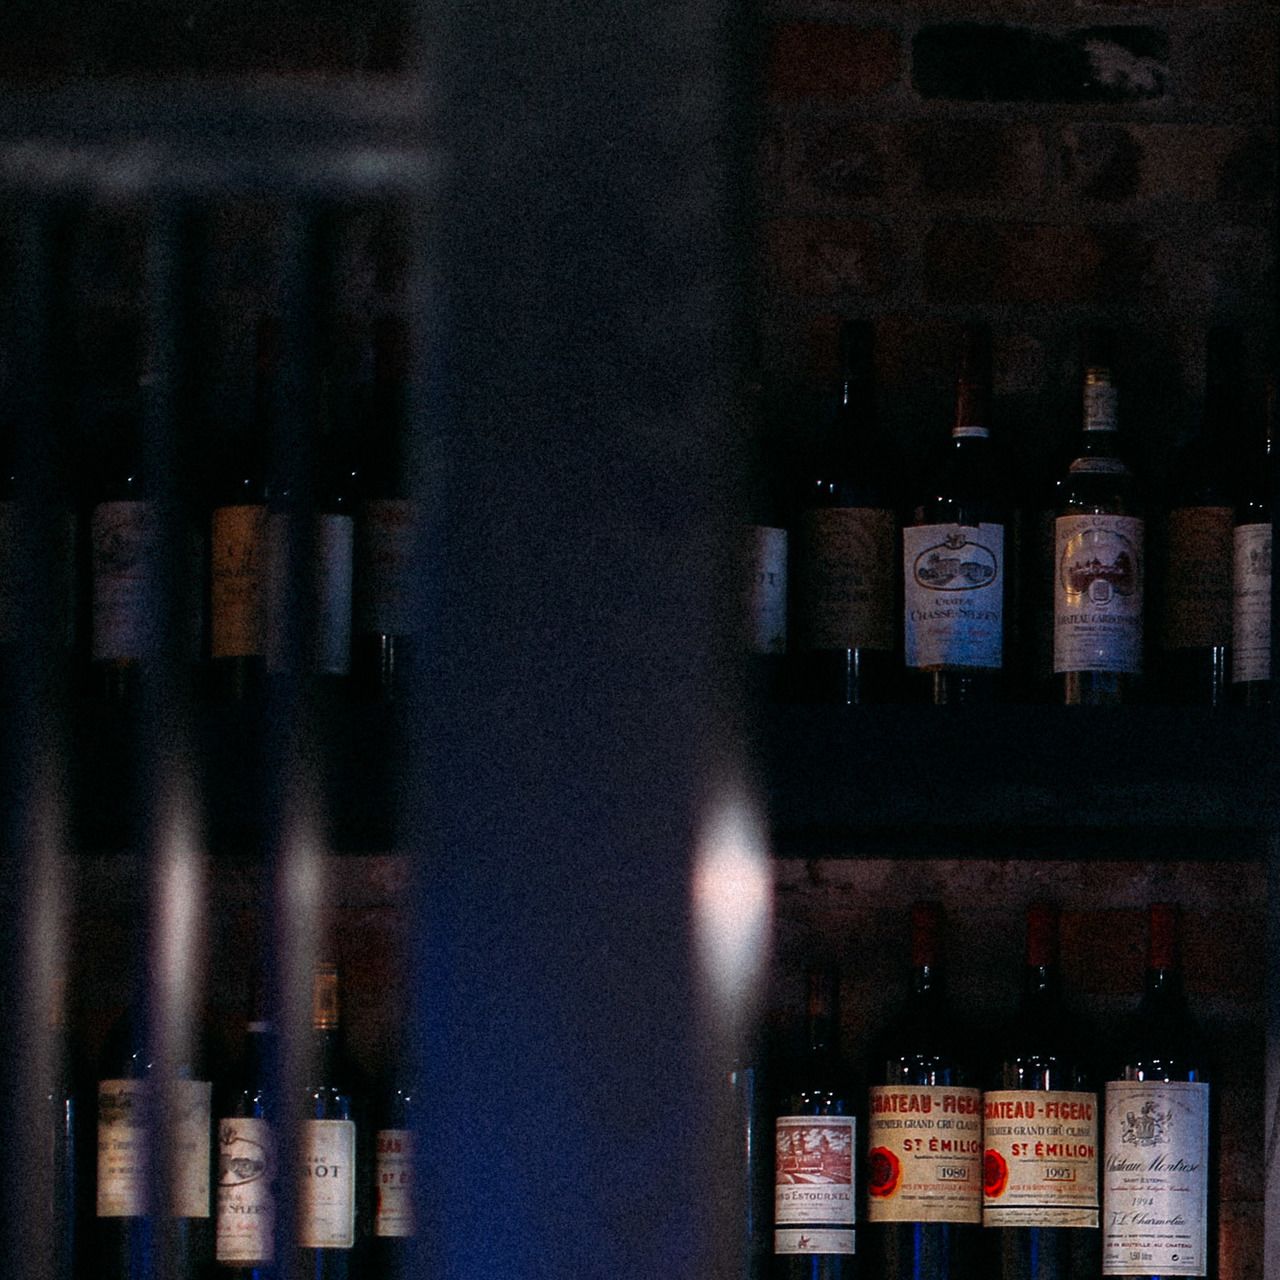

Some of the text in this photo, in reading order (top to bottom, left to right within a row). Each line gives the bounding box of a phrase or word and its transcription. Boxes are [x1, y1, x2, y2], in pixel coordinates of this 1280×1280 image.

[904, 1120, 934, 1129] GRAND
[1014, 1126, 1044, 1136] GRAND
[1035, 1141, 1094, 1158] ÉMILION
[941, 1167, 967, 1179] 1989
